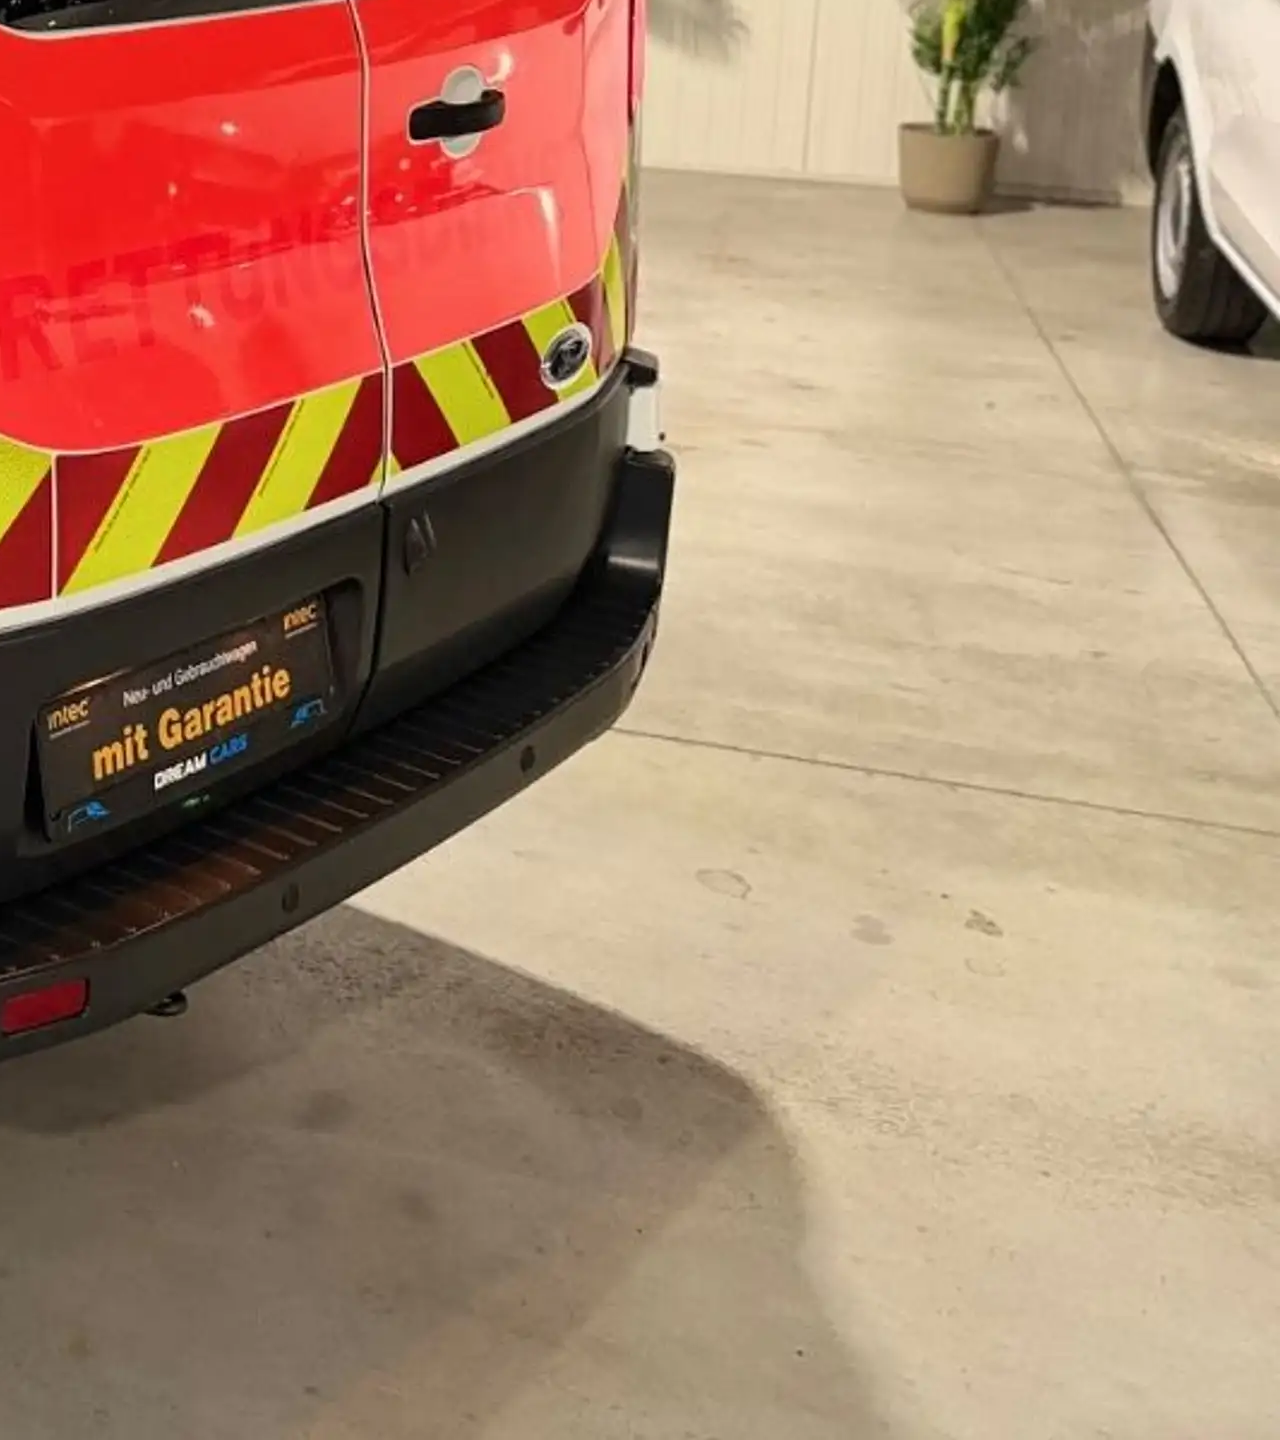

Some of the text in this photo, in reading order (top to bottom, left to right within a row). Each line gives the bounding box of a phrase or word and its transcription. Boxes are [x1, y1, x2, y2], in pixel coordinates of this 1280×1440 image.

[151, 672, 173, 696] und
[92, 664, 291, 780] mit Garantie
[153, 733, 248, 791] DREAM CARS
